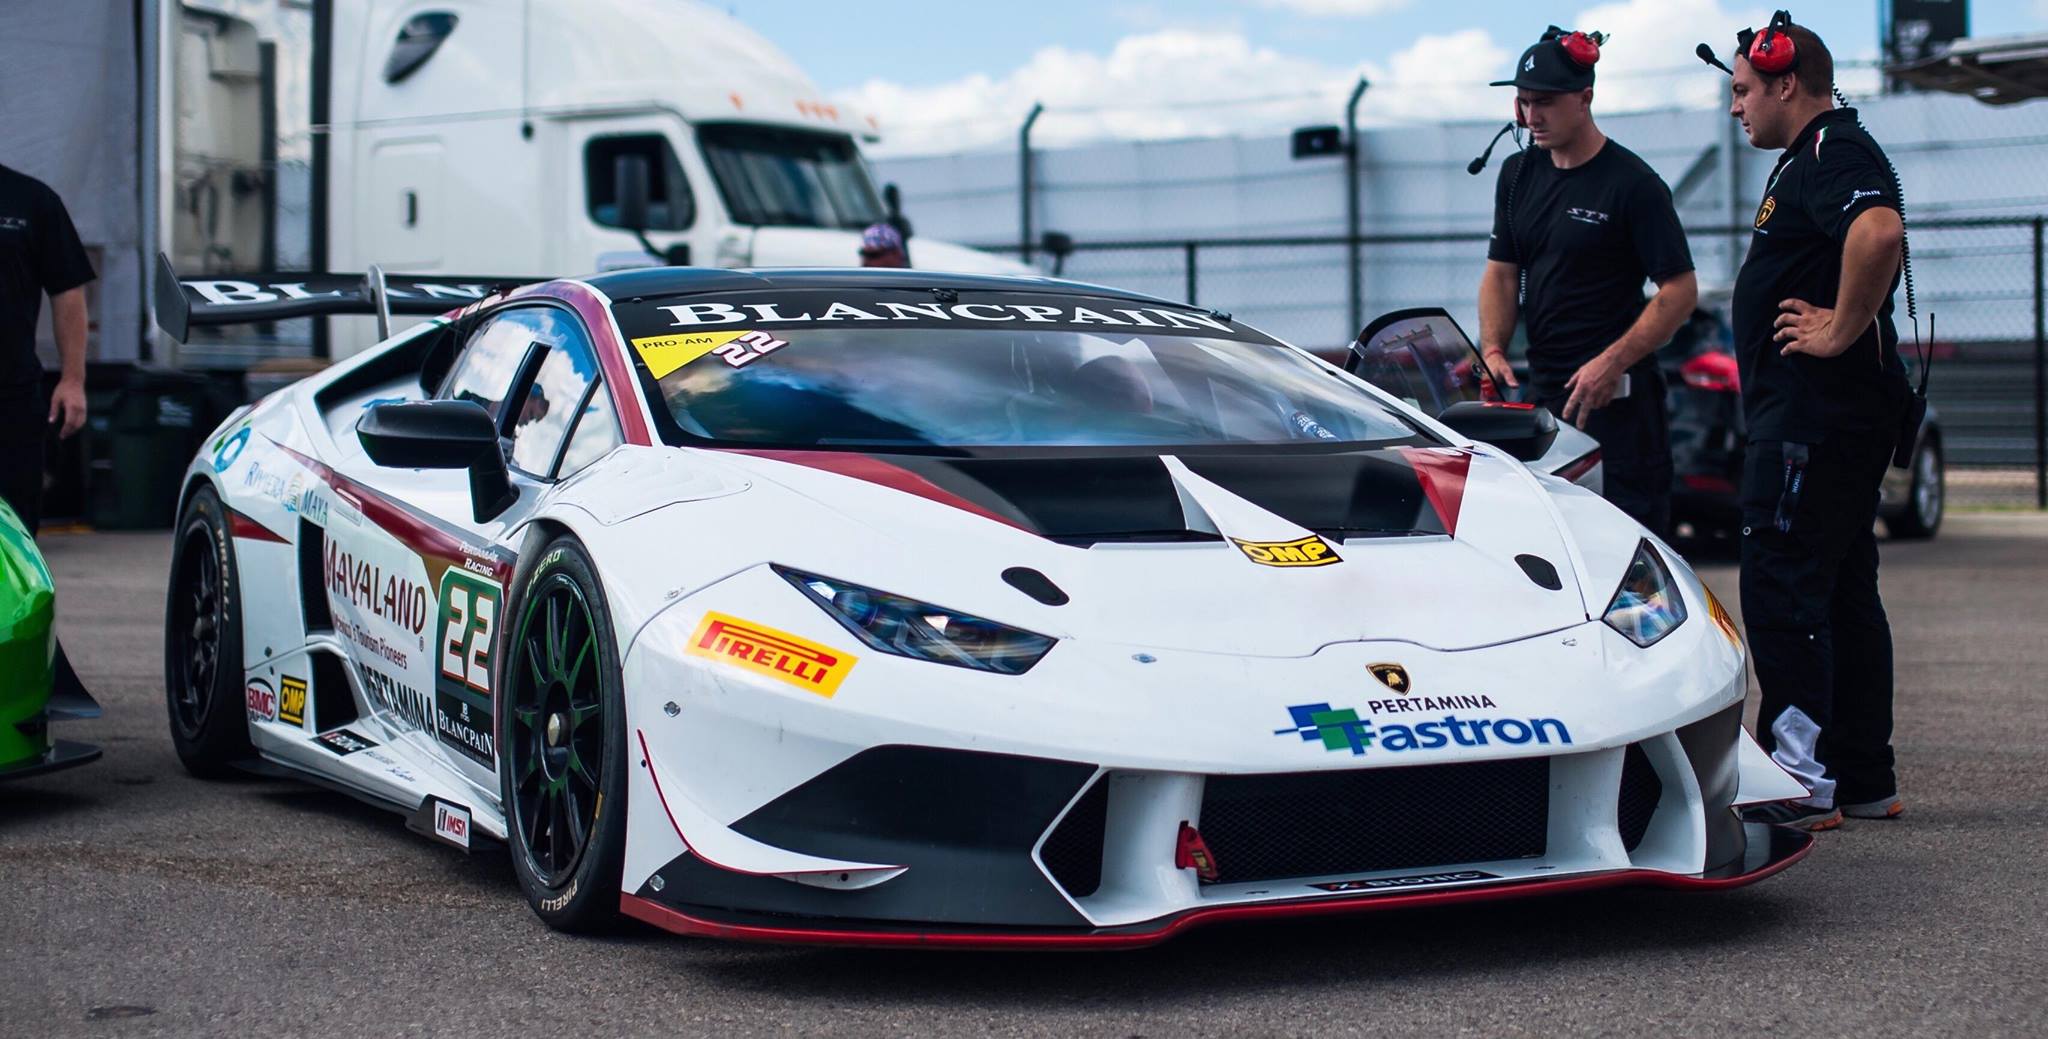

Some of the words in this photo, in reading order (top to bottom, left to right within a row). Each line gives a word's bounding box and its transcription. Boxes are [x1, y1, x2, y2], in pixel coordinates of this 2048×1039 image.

[656, 302, 1235, 333] BLANCPAIN
[642, 336, 714, 350] PRO-AM
[711, 330, 789, 369] 22
[302, 487, 329, 526] MAYA
[464, 557, 494, 577] RACING
[532, 549, 562, 585] ZERO
[1242, 542, 1327, 562] OMP
[324, 535, 427, 635] MAYALAND
[379, 636, 407, 670] Pioneers
[442, 583, 494, 695] 22
[698, 620, 838, 684] PIRELLI
[248, 686, 275, 717] BMC
[281, 686, 305, 716] OMP
[360, 661, 438, 742] PERTAMINA
[1367, 695, 1497, 715] PERTAMINA
[438, 708, 493, 758] BLANCPAIN
[446, 814, 468, 839] IMSA
[541, 879, 578, 912] PIRELLI
